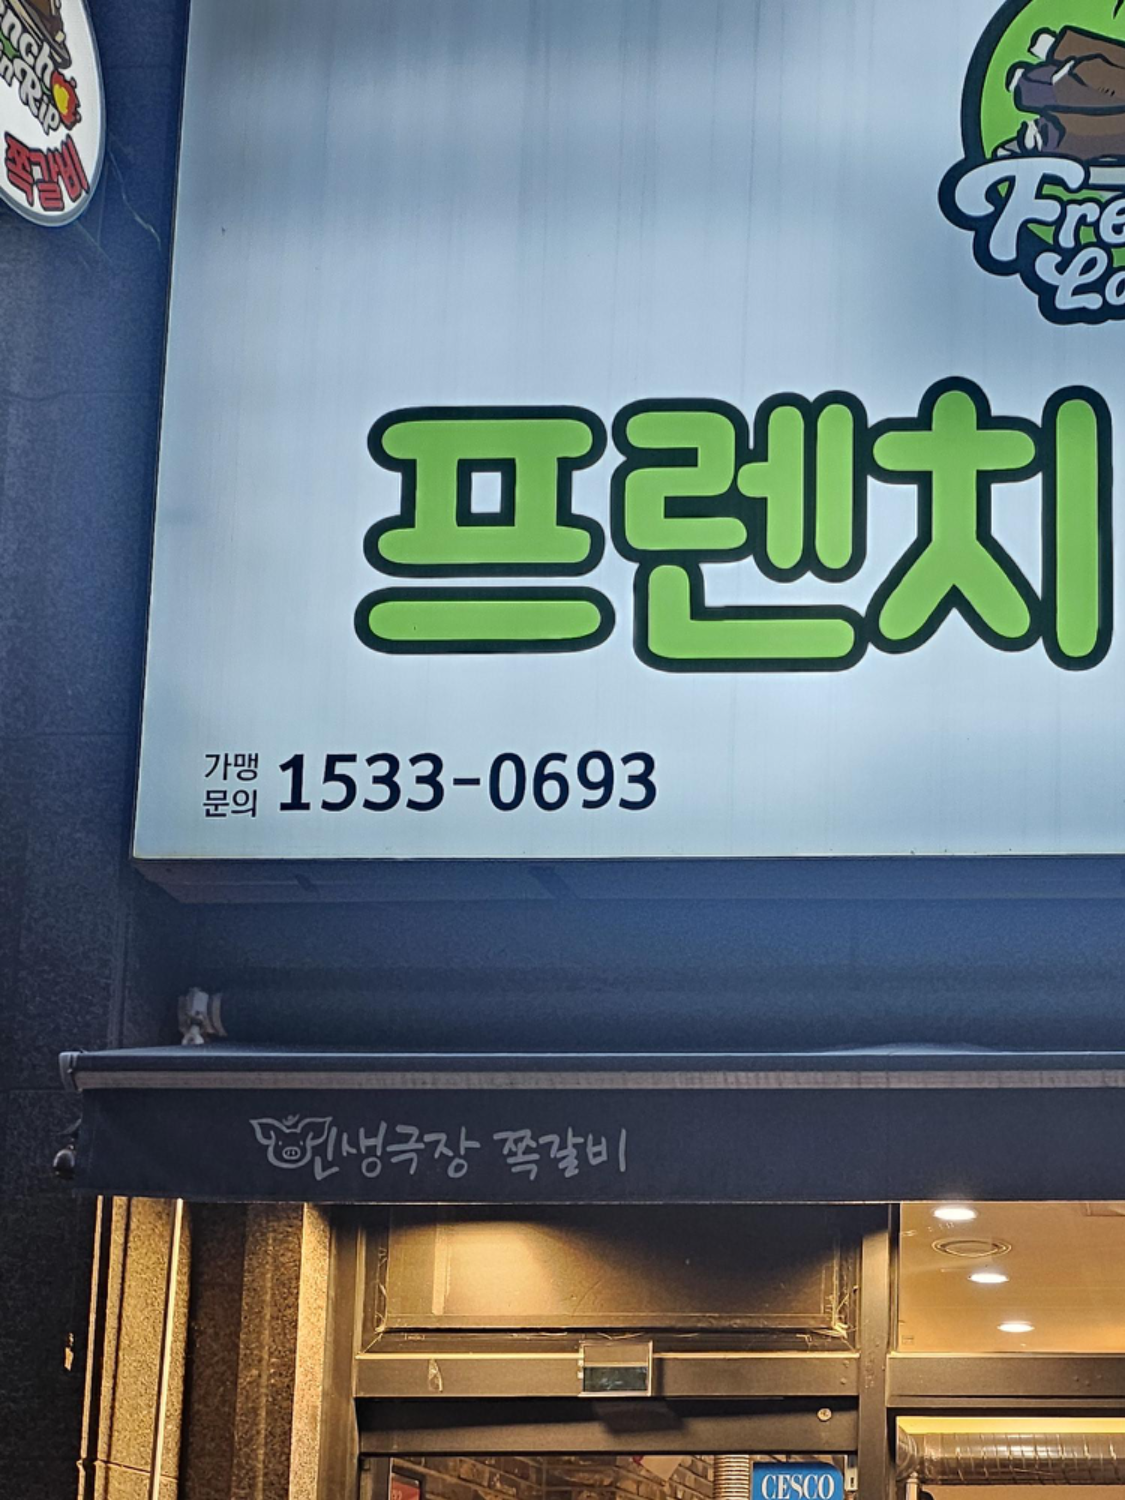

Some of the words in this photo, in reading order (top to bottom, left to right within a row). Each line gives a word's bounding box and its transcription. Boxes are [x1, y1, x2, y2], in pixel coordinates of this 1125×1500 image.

[354, 376, 1112, 672] 프렌치
[204, 752, 259, 782] 가맹
[277, 750, 657, 812] 1533-0693
[202, 788, 257, 818] 문의
[493, 1127, 628, 1180] 쪽갈비
[761, 1473, 835, 1500] CESCO
